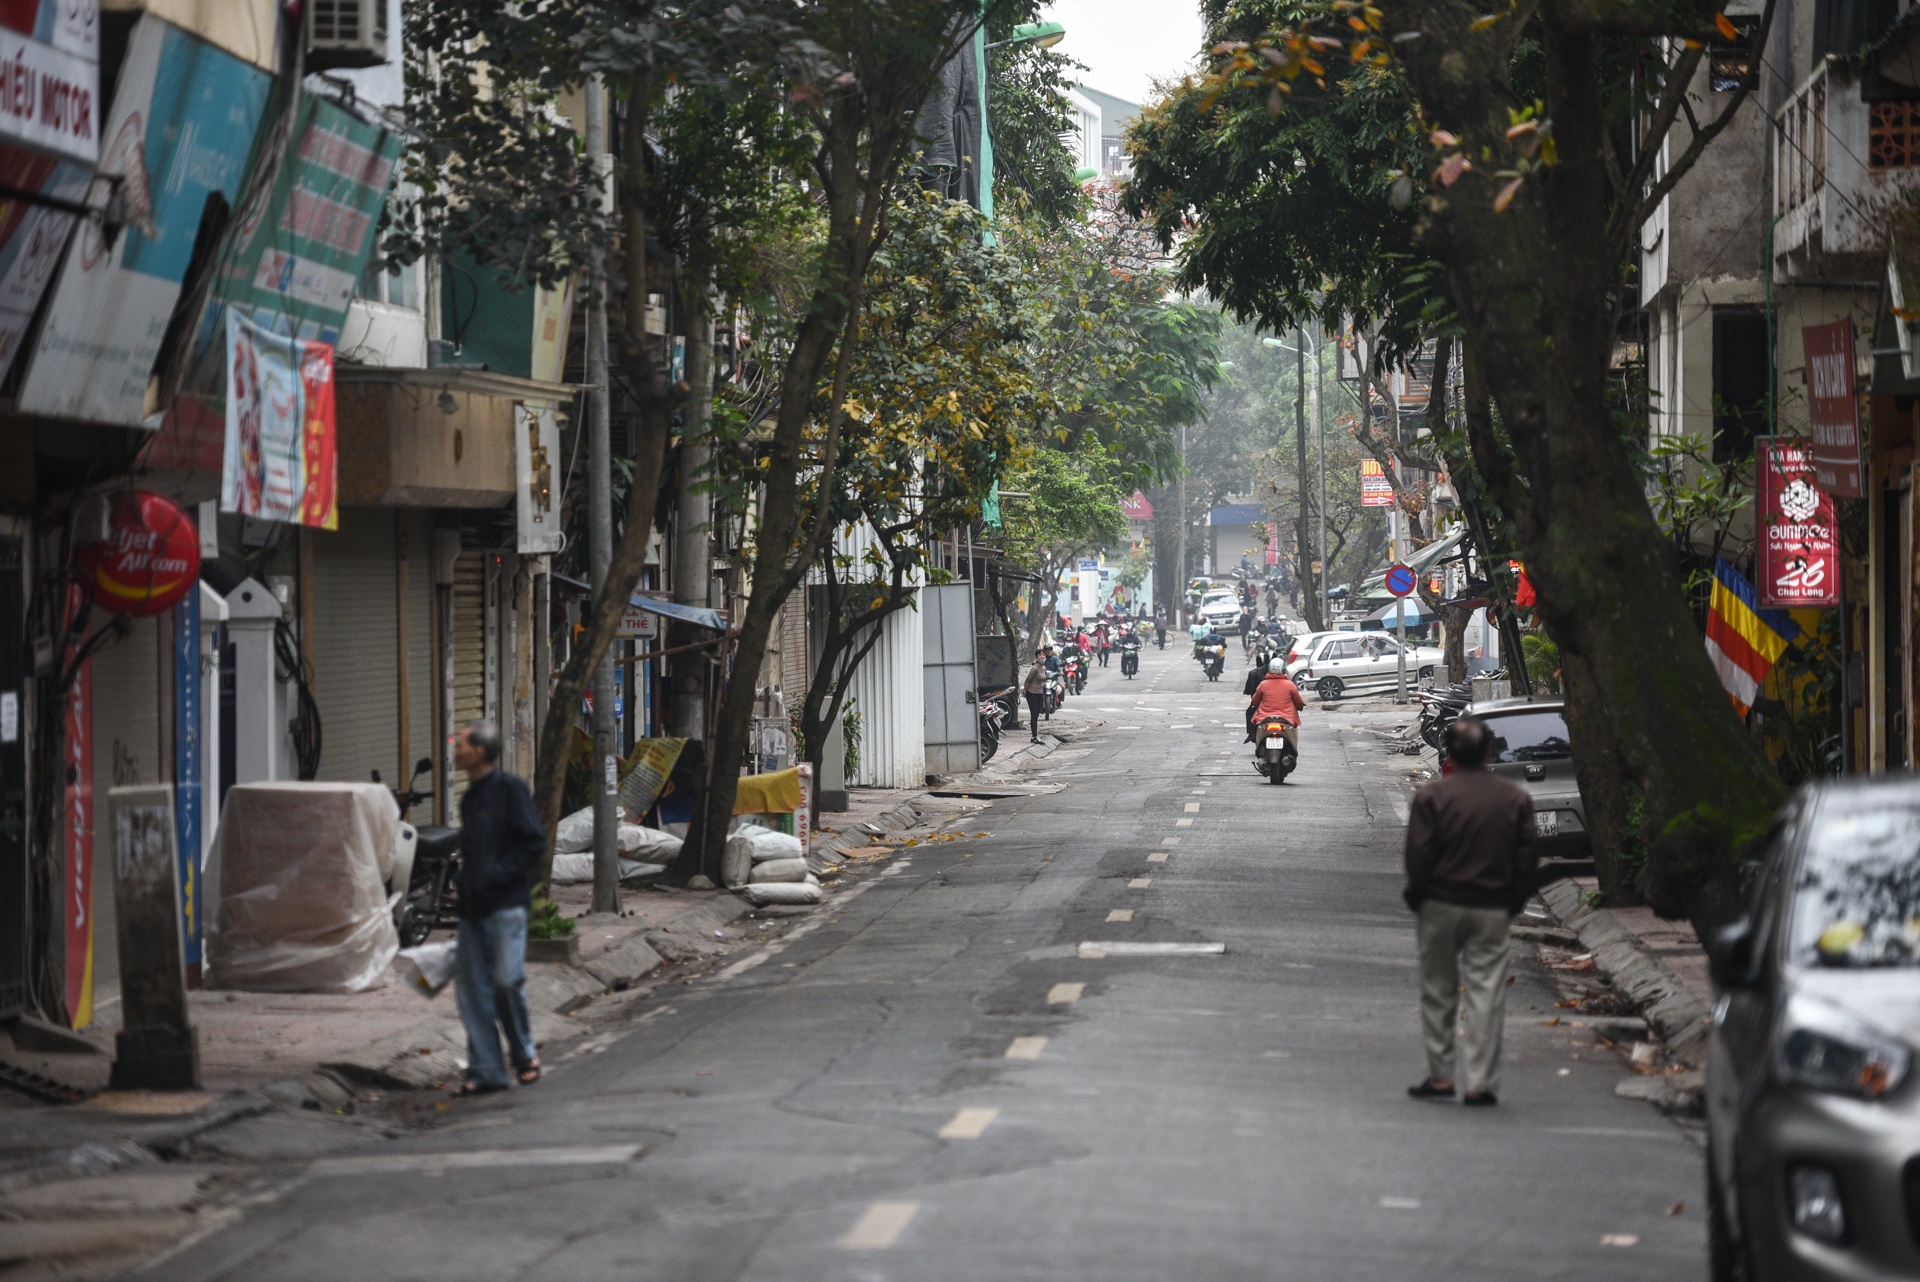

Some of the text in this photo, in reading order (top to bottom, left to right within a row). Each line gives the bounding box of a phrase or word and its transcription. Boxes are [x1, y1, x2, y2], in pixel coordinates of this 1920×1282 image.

[41, 72, 92, 140] MOTOR
[1363, 461, 1384, 475] HOT
[1776, 558, 1825, 587] 26
[1802, 587, 1824, 597] Long
